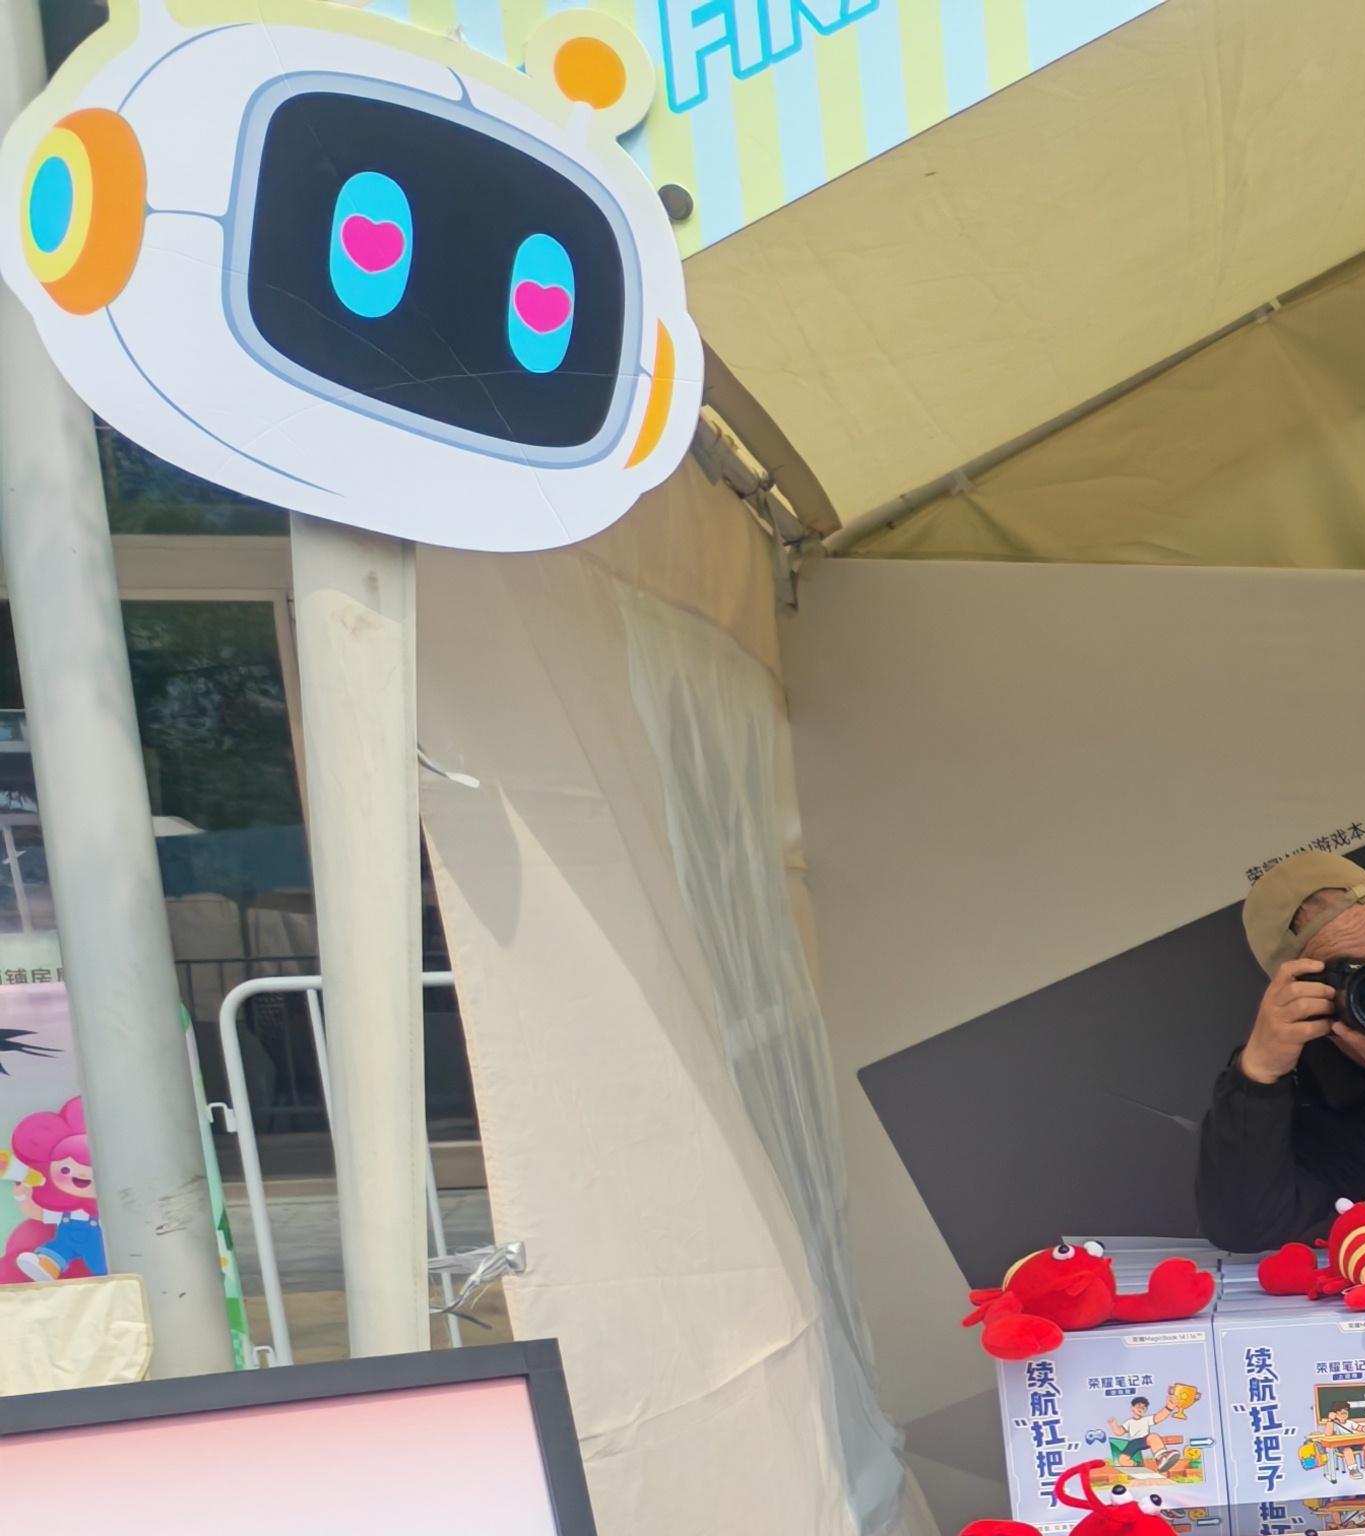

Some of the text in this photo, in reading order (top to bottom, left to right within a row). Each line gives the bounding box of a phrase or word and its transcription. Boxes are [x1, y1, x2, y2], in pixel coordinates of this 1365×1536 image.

[1088, 1374, 1154, 1389] 荣耀笔记本
